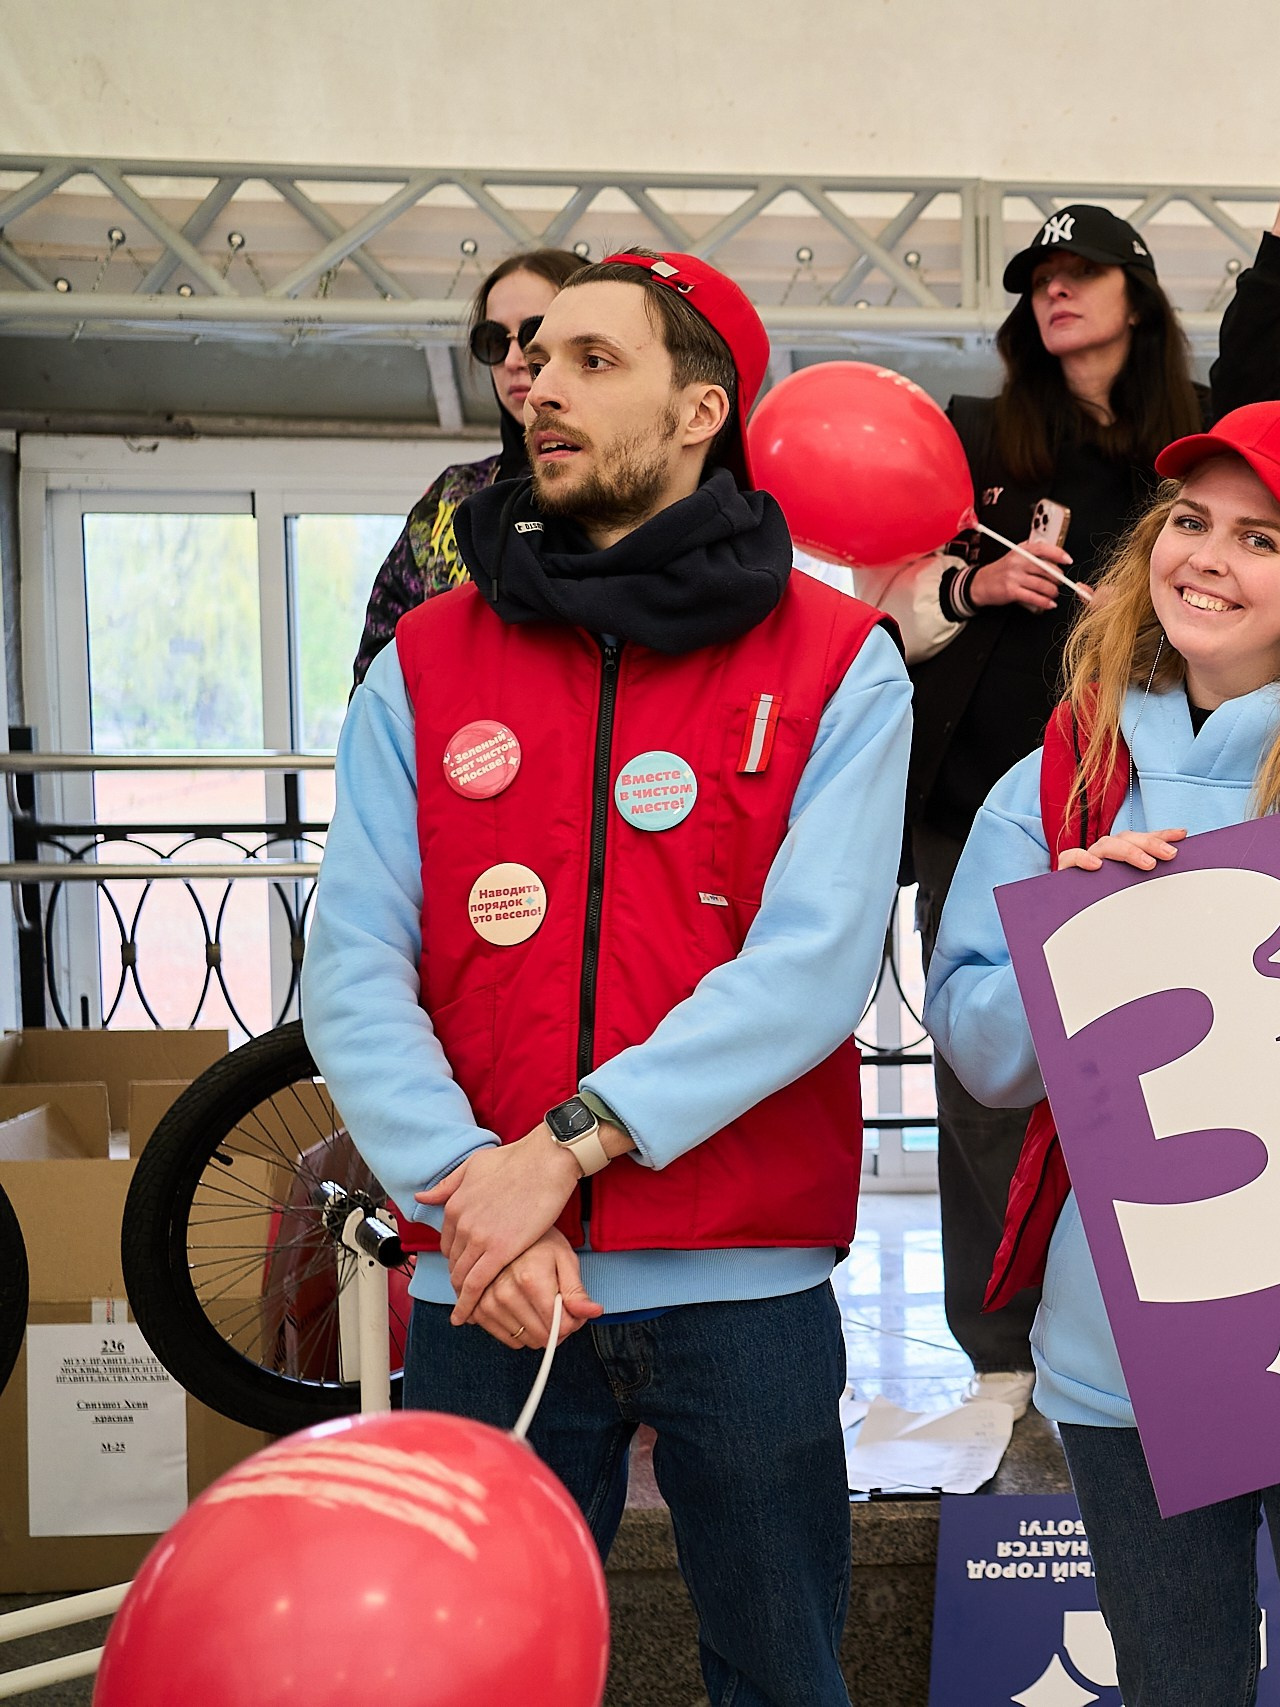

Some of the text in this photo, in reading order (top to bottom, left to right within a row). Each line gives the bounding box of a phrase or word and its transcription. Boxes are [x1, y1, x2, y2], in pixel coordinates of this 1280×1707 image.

[1041, 213, 1076, 246] NY
[454, 731, 507, 764] Зеленый
[450, 737, 517, 778] свет чистой
[458, 755, 507, 786] Москве!
[621, 770, 681, 786] Вместе
[619, 784, 693, 801] в чистом
[631, 797, 685, 815] месте!
[479, 885, 540, 899] Наводить
[470, 898, 523, 913] порядок
[473, 906, 542, 924] это весело!
[101, 1340, 125, 1353] 236
[90, 1357, 160, 1366] ПРАВИТЕЛЬСТВ
[967, 1560, 1046, 1579] ГОРОД
